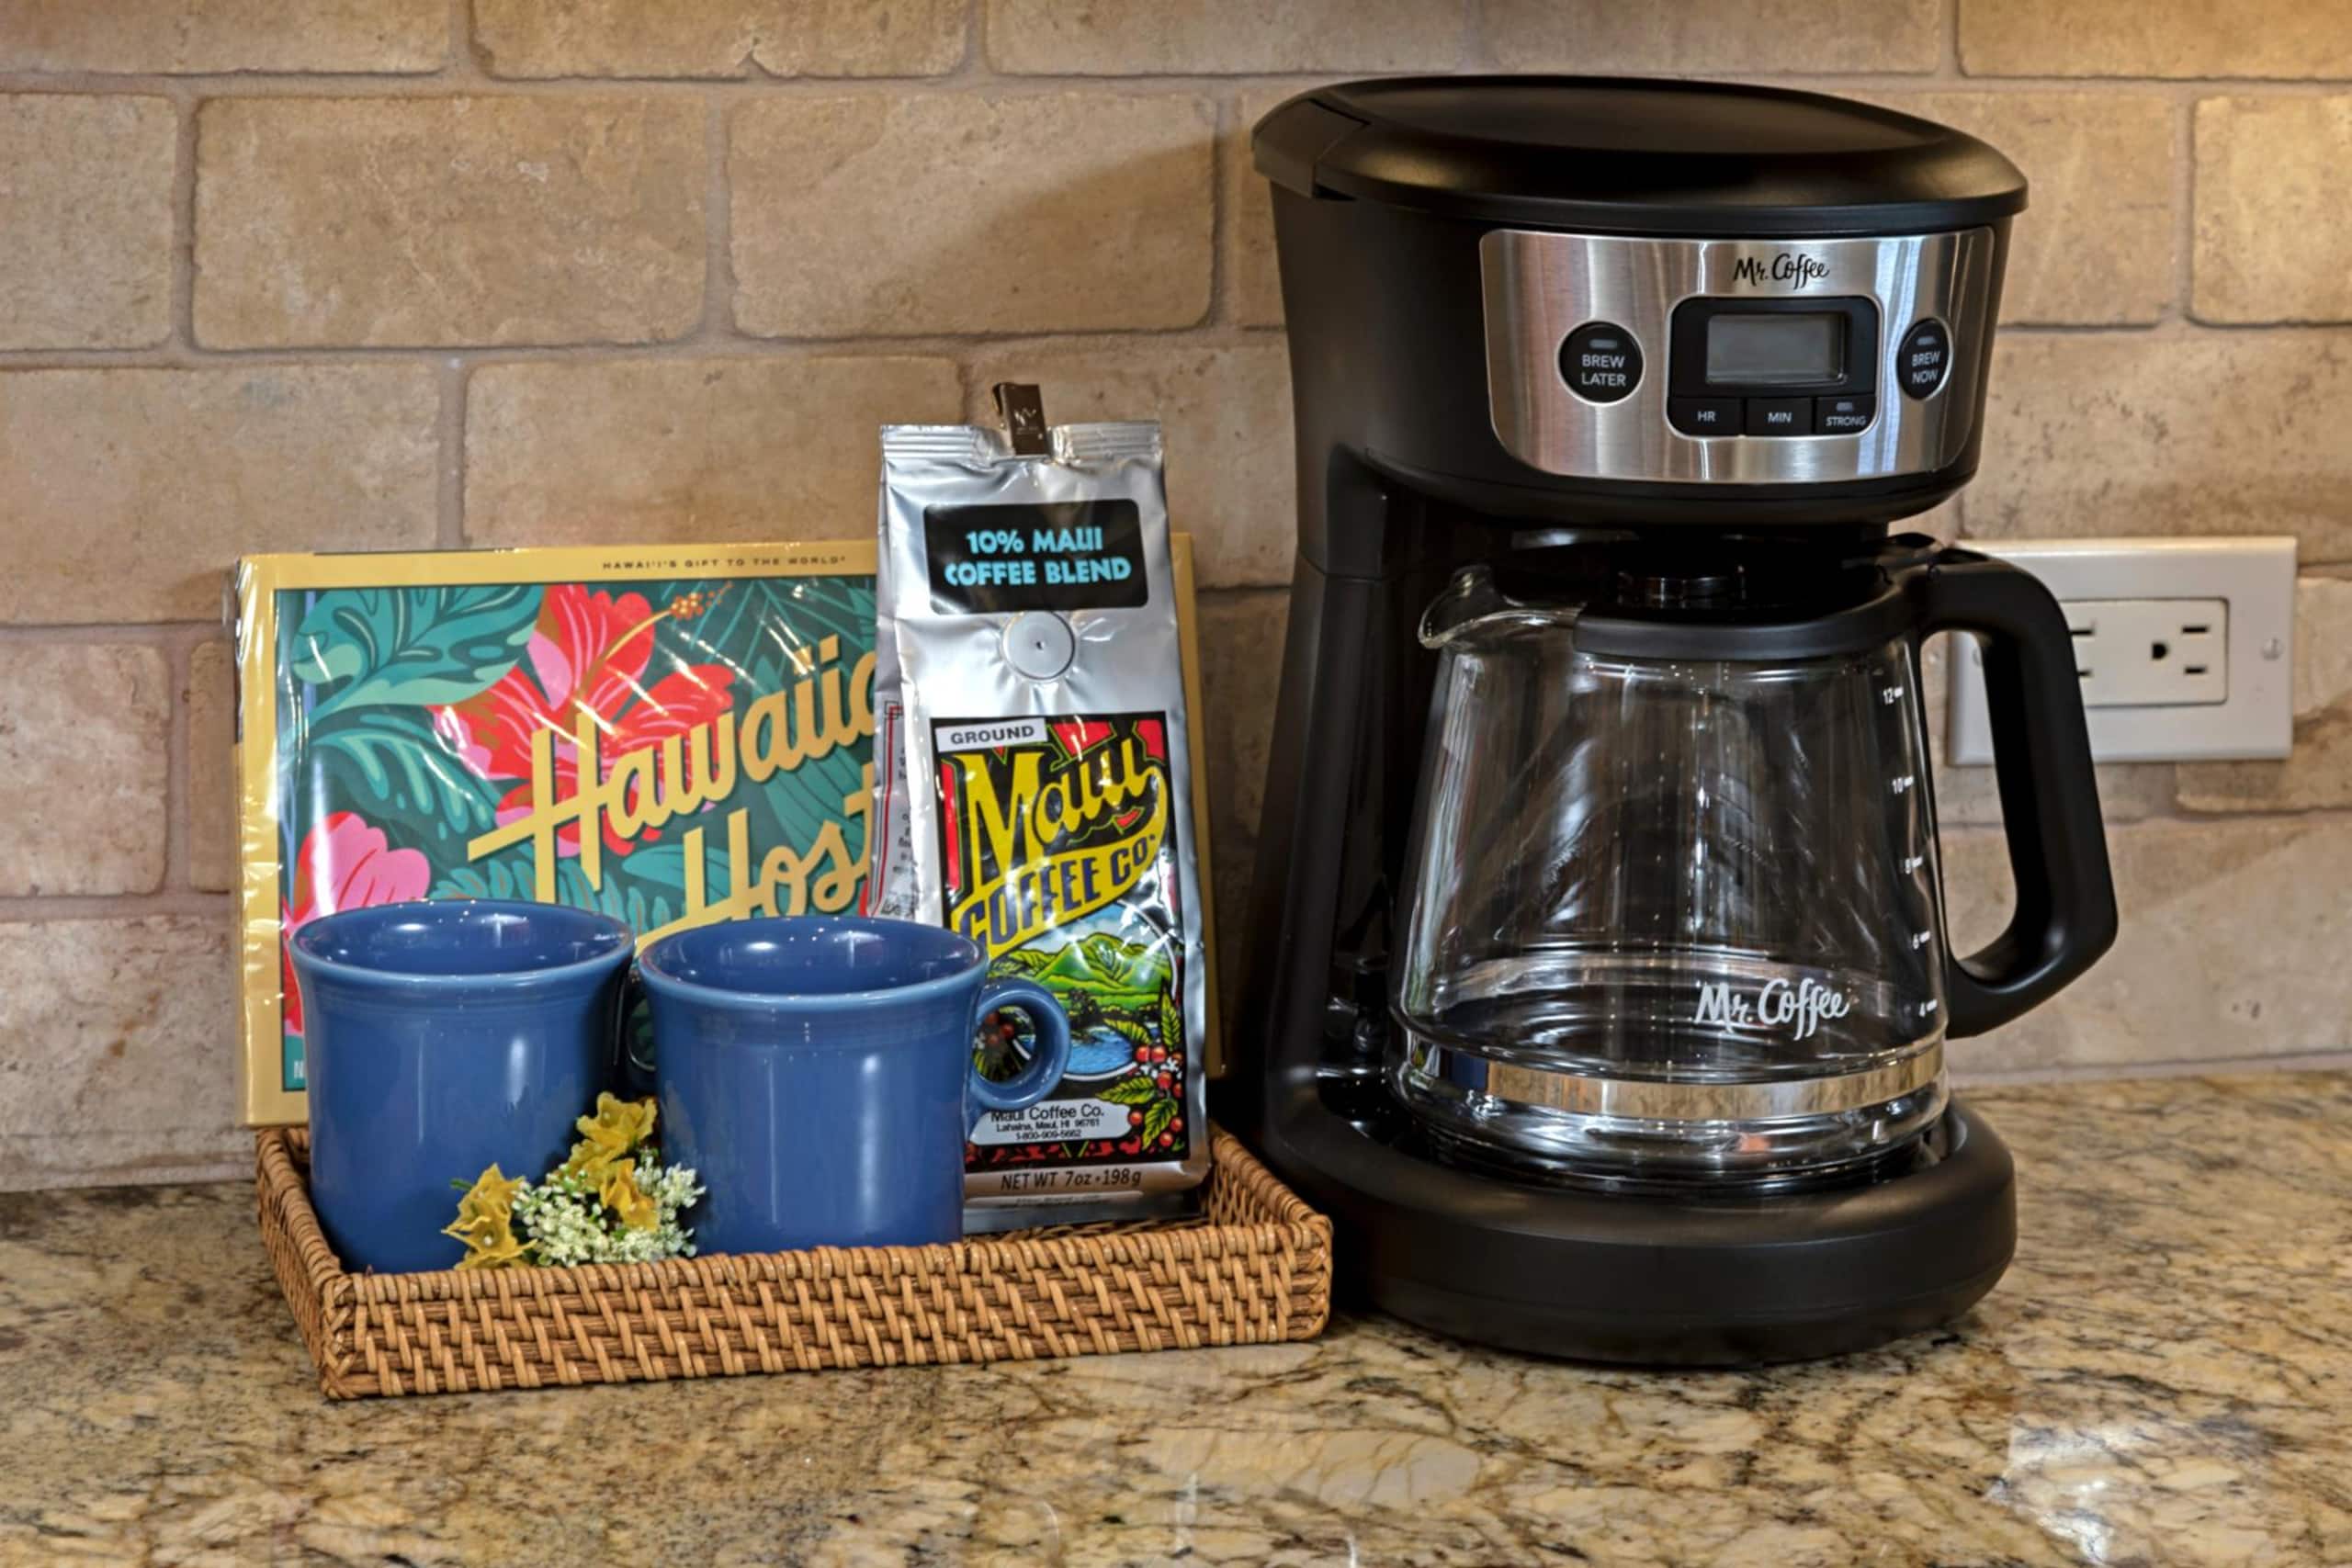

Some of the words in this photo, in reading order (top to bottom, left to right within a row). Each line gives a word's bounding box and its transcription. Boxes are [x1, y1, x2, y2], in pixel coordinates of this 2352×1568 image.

[1733, 257, 1769, 286] Mr.
[1771, 253, 1830, 290] Coffee
[1581, 354, 1625, 368] BREW
[1911, 351, 1940, 367] BREW
[1581, 371, 1626, 387] LATER
[1911, 370, 1939, 384] NOW
[1697, 410, 1717, 423] HR
[1768, 411, 1792, 423] MIN
[1826, 415, 1867, 427] STRONG
[966, 529, 1025, 554] 10%
[1032, 526, 1103, 553] MAUI
[684, 558, 719, 568] GIFT
[727, 558, 745, 567] TO
[752, 557, 780, 566] THE
[944, 560, 1037, 586] COFFEE
[1044, 557, 1133, 584] BLEND
[950, 725, 1035, 745] GROUND
[468, 634, 876, 904] Hawaiia
[952, 738, 1149, 893] Maui
[959, 856, 1102, 945] COFFEE
[1694, 981, 1754, 1034] Mr.
[1758, 977, 1850, 1041] Coffee
[990, 1109, 1026, 1122] Maui
[1028, 1106, 1078, 1121] Coffee
[1080, 1103, 1105, 1117] Co.
[1060, 1120, 1070, 1128] HI
[1001, 1174, 1032, 1191] NET
[1034, 1172, 1058, 1188] WT
